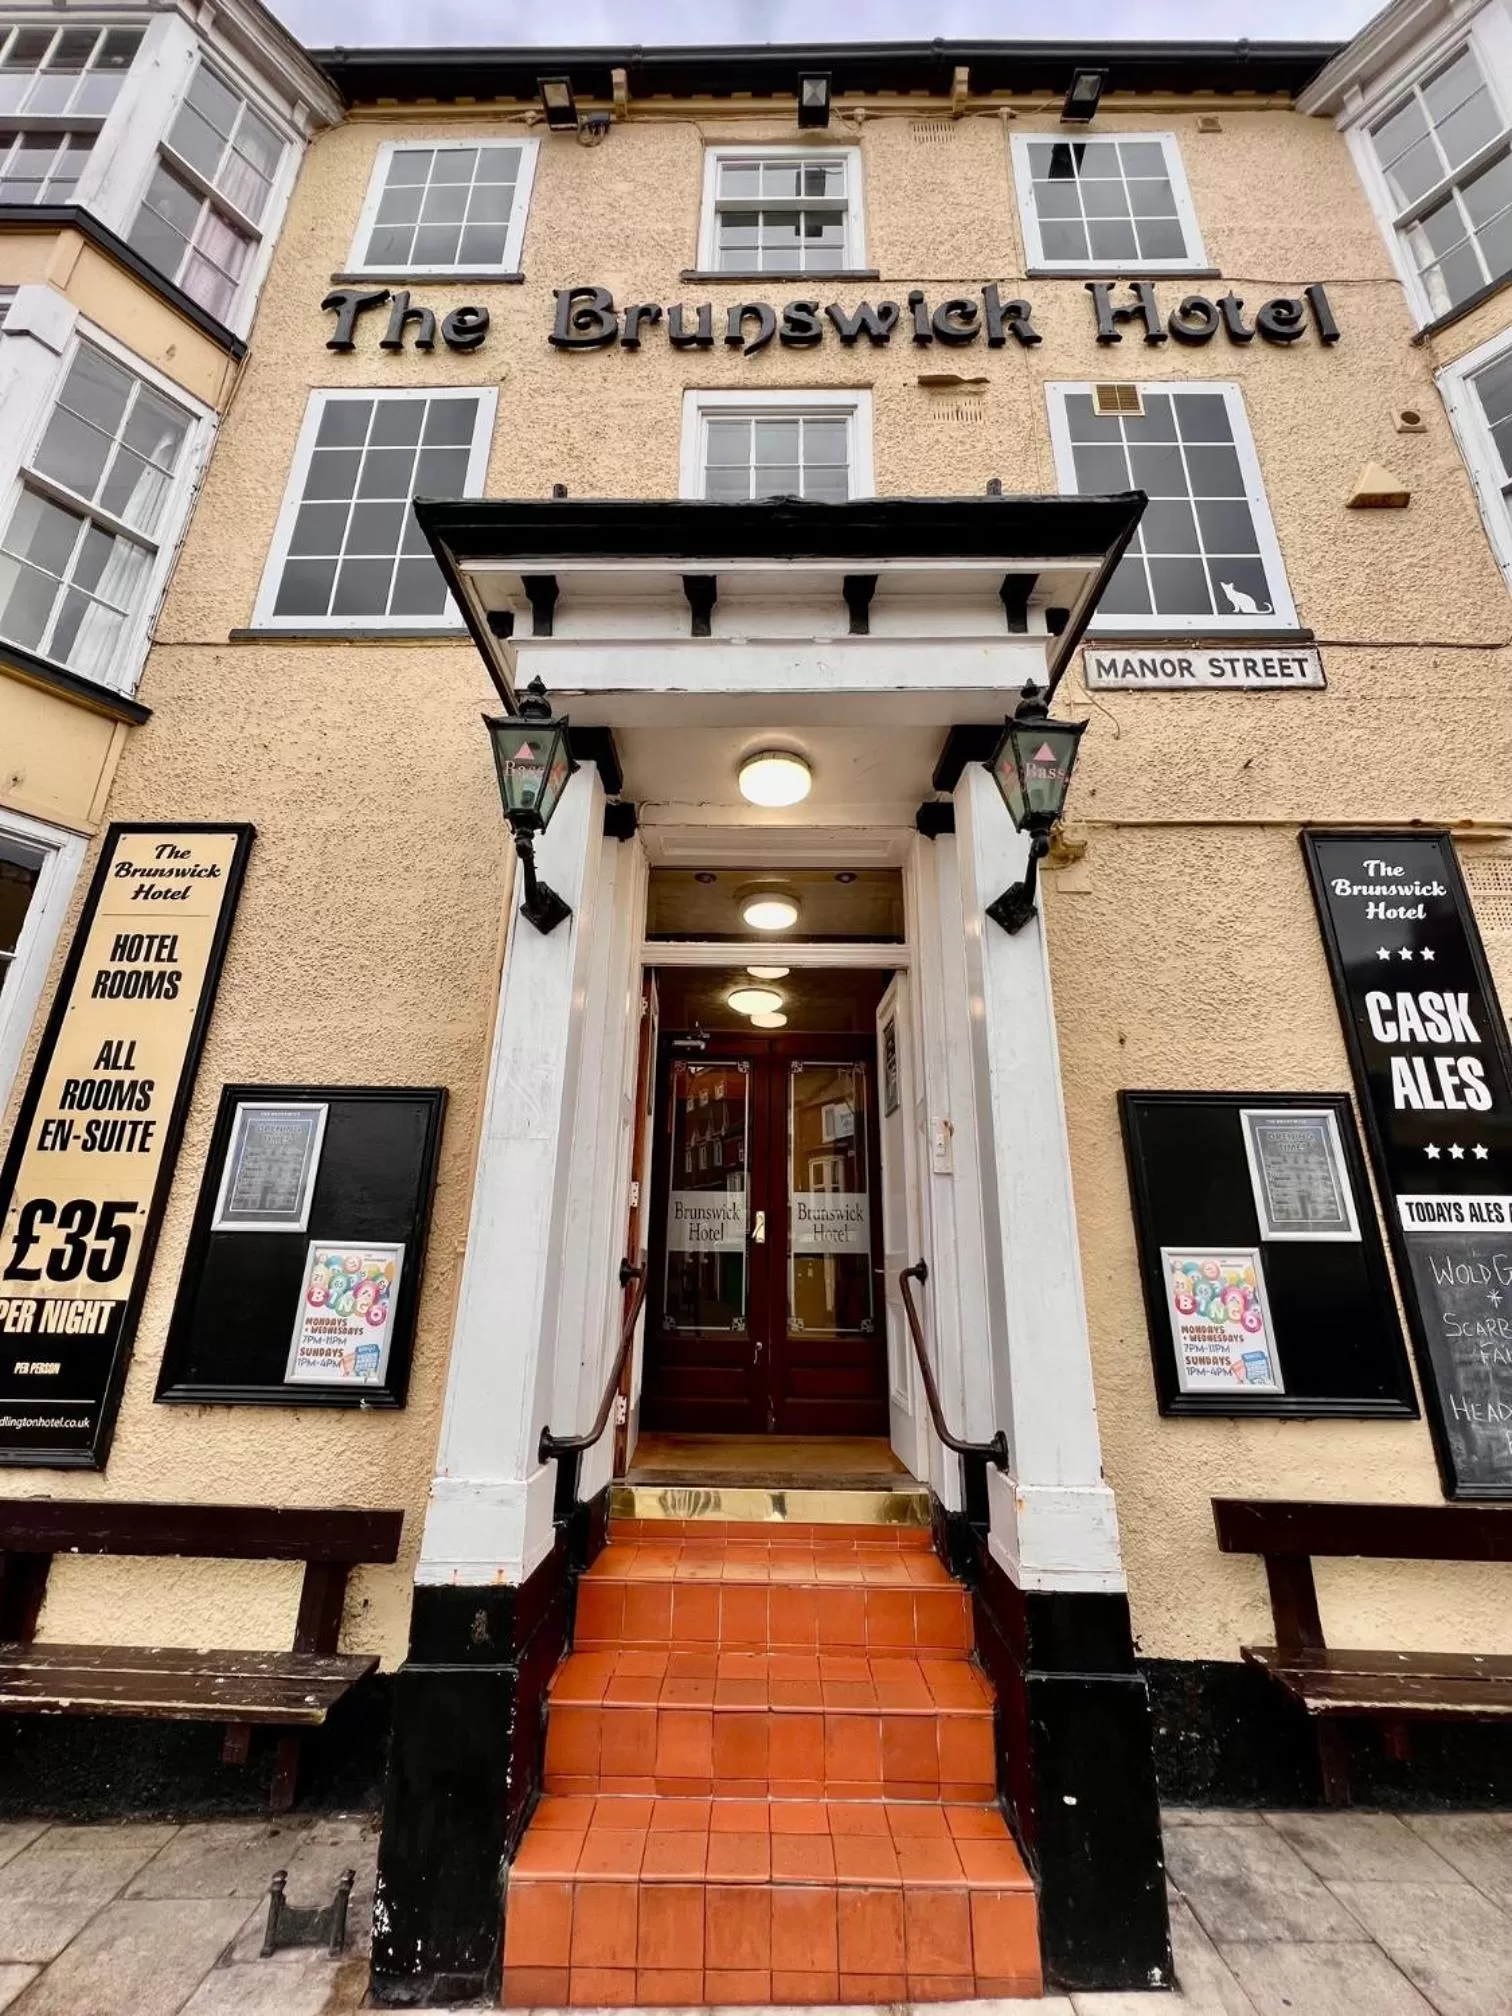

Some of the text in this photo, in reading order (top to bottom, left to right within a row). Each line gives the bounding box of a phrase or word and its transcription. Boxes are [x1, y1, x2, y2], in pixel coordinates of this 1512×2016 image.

[321, 282, 1339, 356] The Brunswick Hotel
[1096, 657, 1310, 679] MANOR STREET
[155, 843, 192, 859] The
[114, 862, 222, 879] Brunswick
[1362, 859, 1405, 877] The
[131, 884, 193, 901] Hotel
[1330, 879, 1446, 897] Brunswick
[1365, 902, 1426, 920] Hotel
[110, 934, 179, 963] HOTEL
[91, 970, 182, 1000] ROOMS
[1365, 991, 1482, 1043] CASK
[93, 1040, 137, 1071] ALL
[1390, 1056, 1493, 1111] ALES
[59, 1079, 155, 1111] ROOMS
[37, 1119, 156, 1152] EN-SUITE
[675, 1201, 740, 1221] Brunswick
[798, 1202, 864, 1222] Brunswick
[1405, 1202, 1465, 1223] TODAYS
[1469, 1202, 1505, 1223] ALES
[3, 1199, 139, 1282] £35
[689, 1222, 724, 1241] Hotel
[813, 1223, 849, 1242] Hotel
[1429, 1255, 1491, 1286] WOLD
[38, 1300, 116, 1334] NIGHT
[305, 1317, 348, 1326] MONDAYS
[311, 1326, 364, 1335] WEDNESDAYS
[1181, 1325, 1225, 1334] MONDAYS
[1189, 1334, 1244, 1342] WEDNESDAYS
[300, 1347, 344, 1357] SUNDAYS
[1183, 1344, 1230, 1353] 7PM-11PM
[14, 1362, 61, 1374] PER PERSON
[1185, 1356, 1231, 1365] SUNDAYS
[1186, 1367, 1233, 1376] 1PM-4PM
